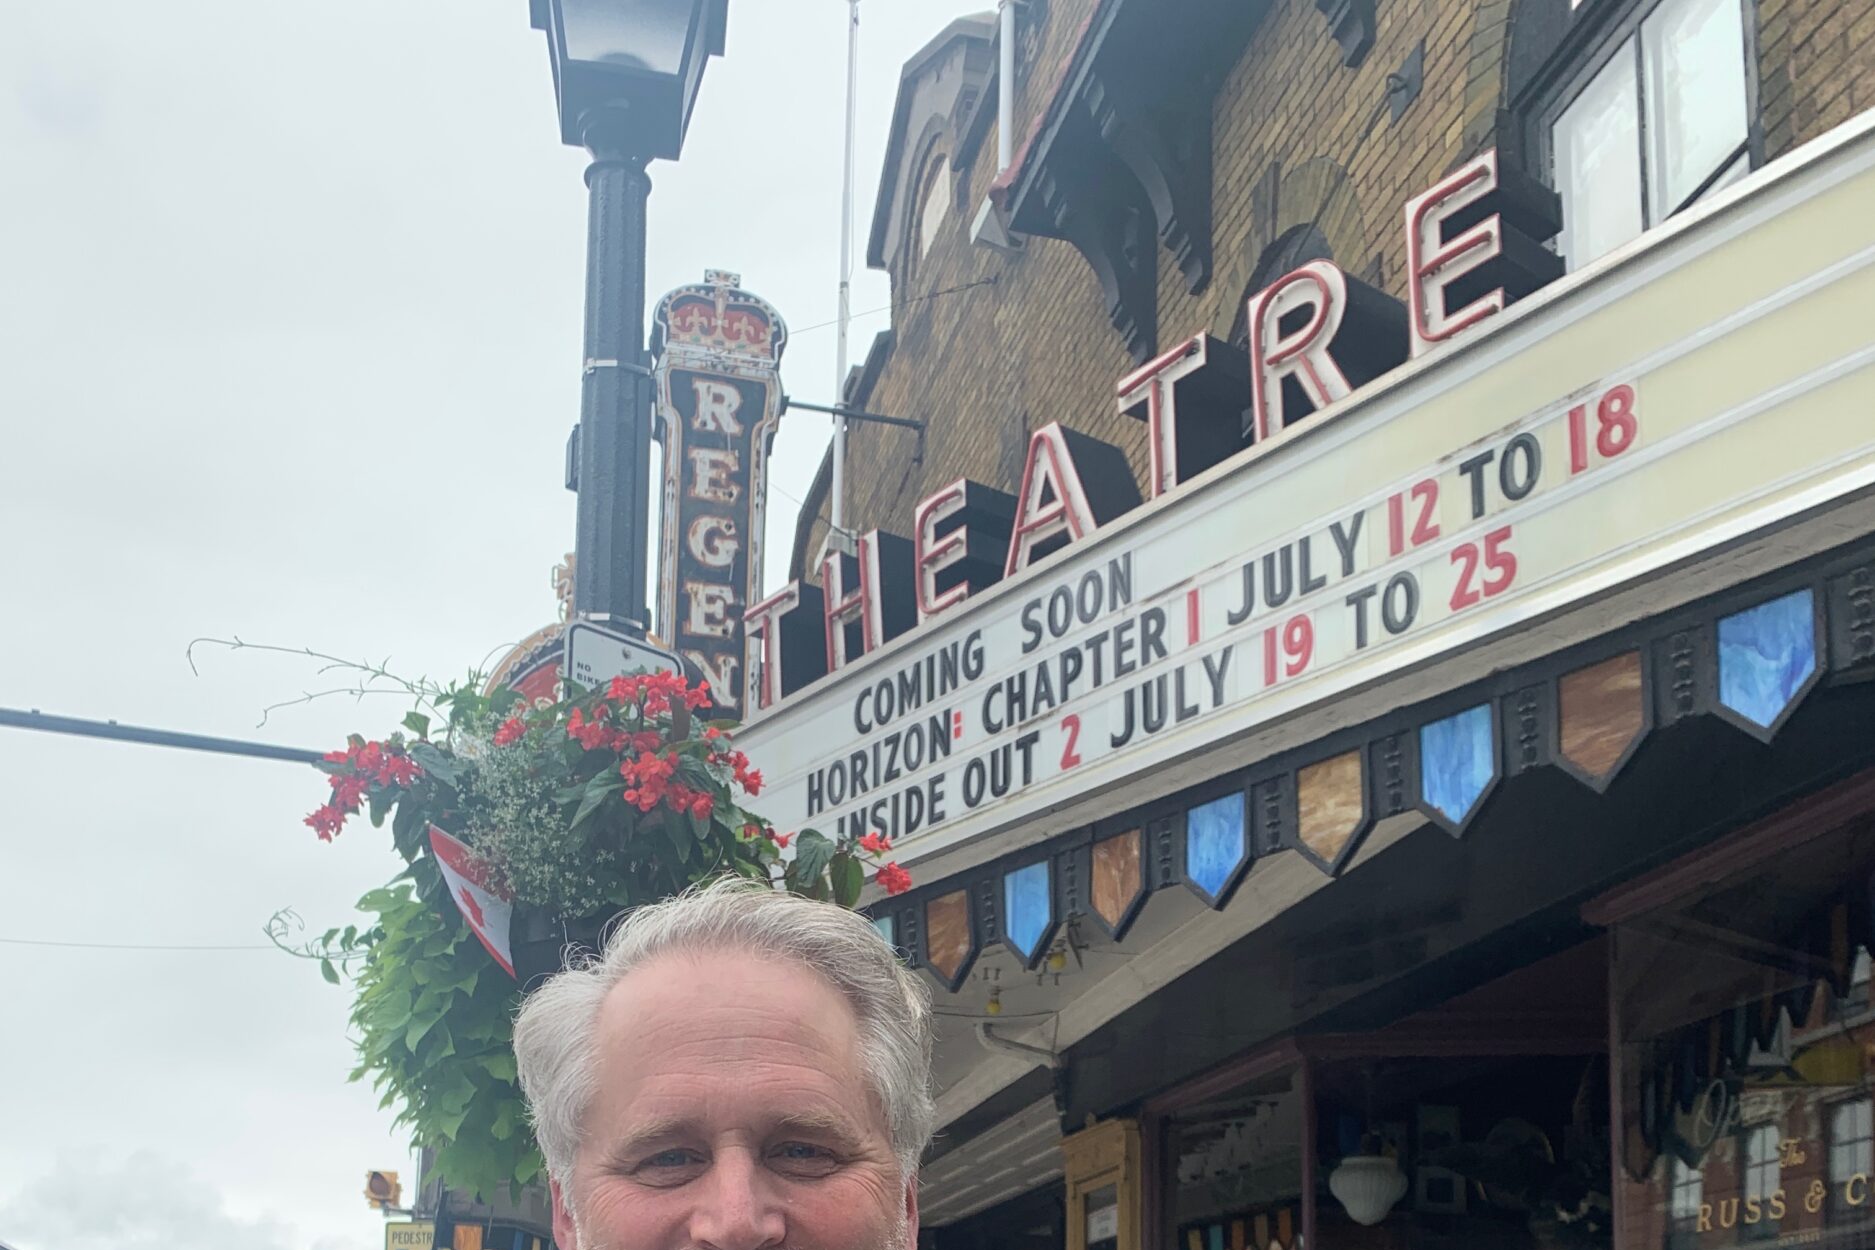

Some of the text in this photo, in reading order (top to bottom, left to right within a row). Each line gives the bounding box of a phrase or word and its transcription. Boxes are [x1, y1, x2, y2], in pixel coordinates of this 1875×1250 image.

[744, 149, 1504, 708] THEATRE
[683, 376, 743, 708] REGEN
[806, 706, 963, 818] HORIZON:
[981, 606, 1169, 735] CHAPTER
[1226, 509, 1365, 627] JULY
[1387, 477, 1441, 558] 12
[1459, 431, 1543, 521] TO
[1567, 383, 1638, 476] 18
[577, 661, 591, 672] NO
[837, 524, 1518, 848] INSIDE OUT 2 JULY 19 TO 25
[854, 550, 1133, 735] COMING SOON
[392, 1231, 433, 1245] PEDESTR
[1695, 1172, 1875, 1233] RUSS & C
[1779, 1138, 1807, 1168] The
